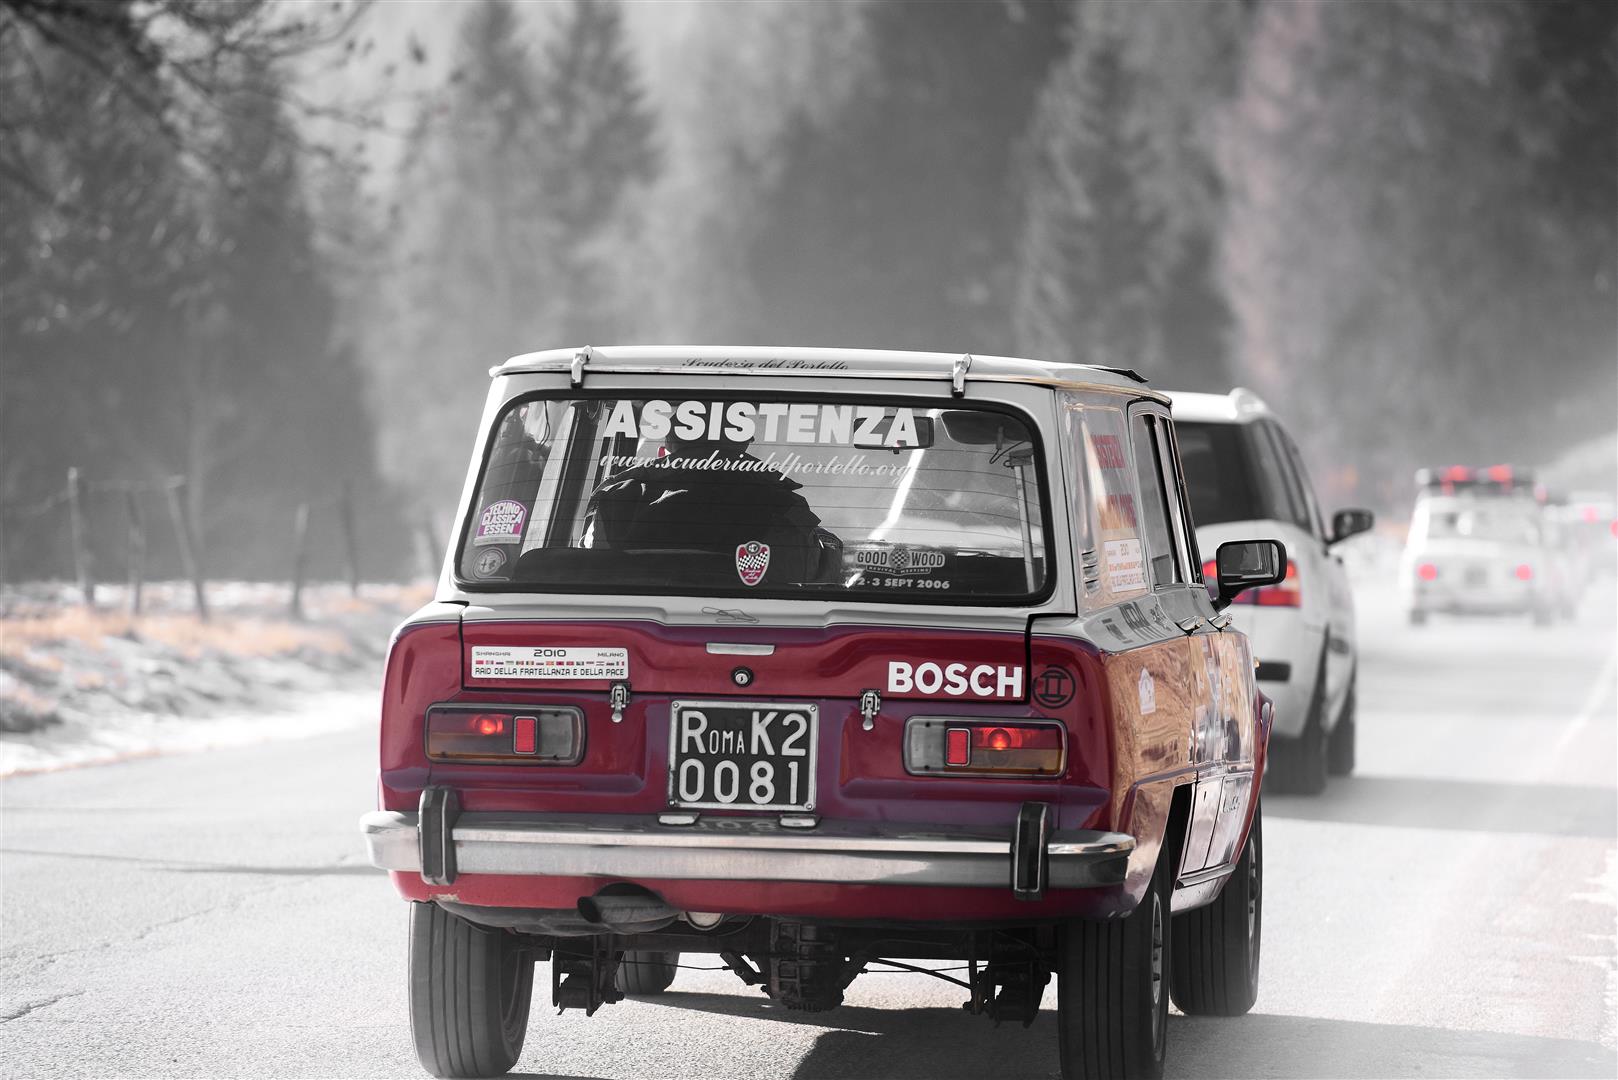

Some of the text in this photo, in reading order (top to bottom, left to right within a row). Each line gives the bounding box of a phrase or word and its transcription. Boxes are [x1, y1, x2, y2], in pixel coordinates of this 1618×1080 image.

[758, 359, 787, 369] del
[602, 400, 919, 447] ASSISTENZA
[600, 450, 913, 485] www.scuderiadelportello.org
[489, 502, 520, 515] TECHNO
[481, 510, 523, 526] CLASSICA
[483, 523, 514, 535] ESSEN
[857, 551, 945, 567] GOOD WOOD
[884, 578, 914, 588] SEPT
[917, 579, 950, 590] 2006
[533, 649, 567, 658] 2010
[475, 667, 491, 675] RAID
[494, 667, 517, 675] DELLA
[520, 668, 570, 676] FRATELLANZA
[580, 668, 603, 676] DELLA
[605, 668, 625, 676] PACE
[887, 661, 1023, 698] BOSCH
[679, 758, 799, 805] 0081
